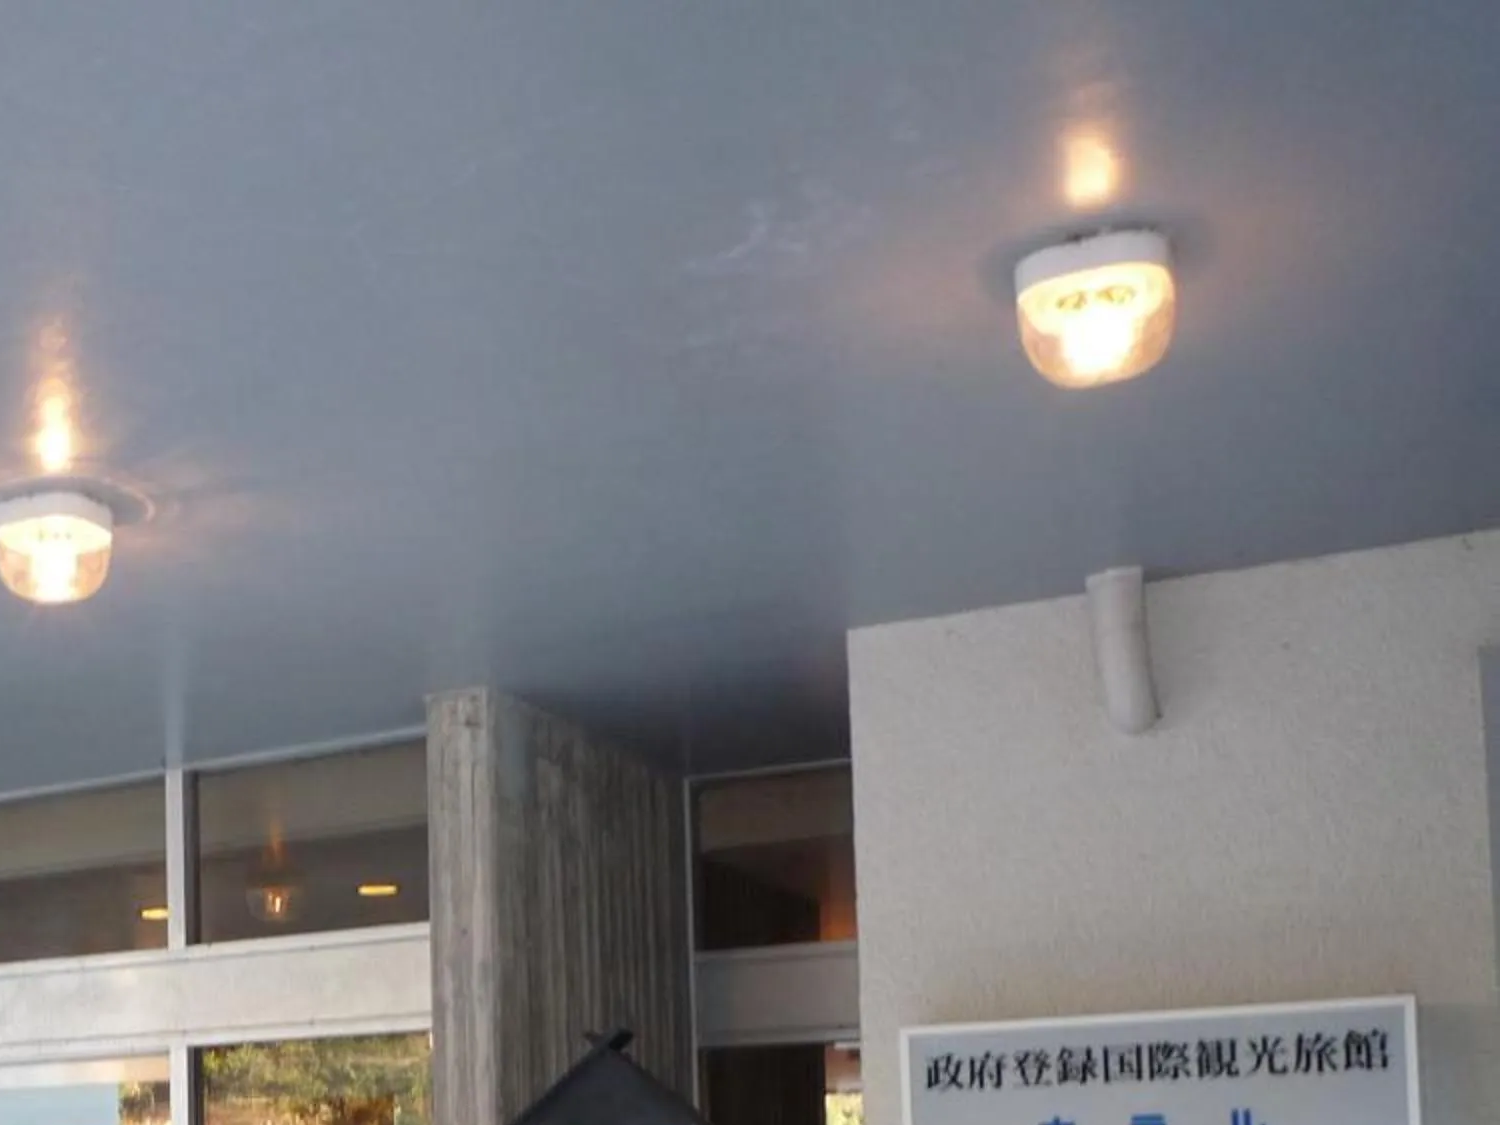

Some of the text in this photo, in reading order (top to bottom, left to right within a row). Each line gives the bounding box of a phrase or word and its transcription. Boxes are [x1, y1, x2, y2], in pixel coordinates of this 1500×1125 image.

[926, 1027, 1390, 1091] 政府登録国際観光旅館
